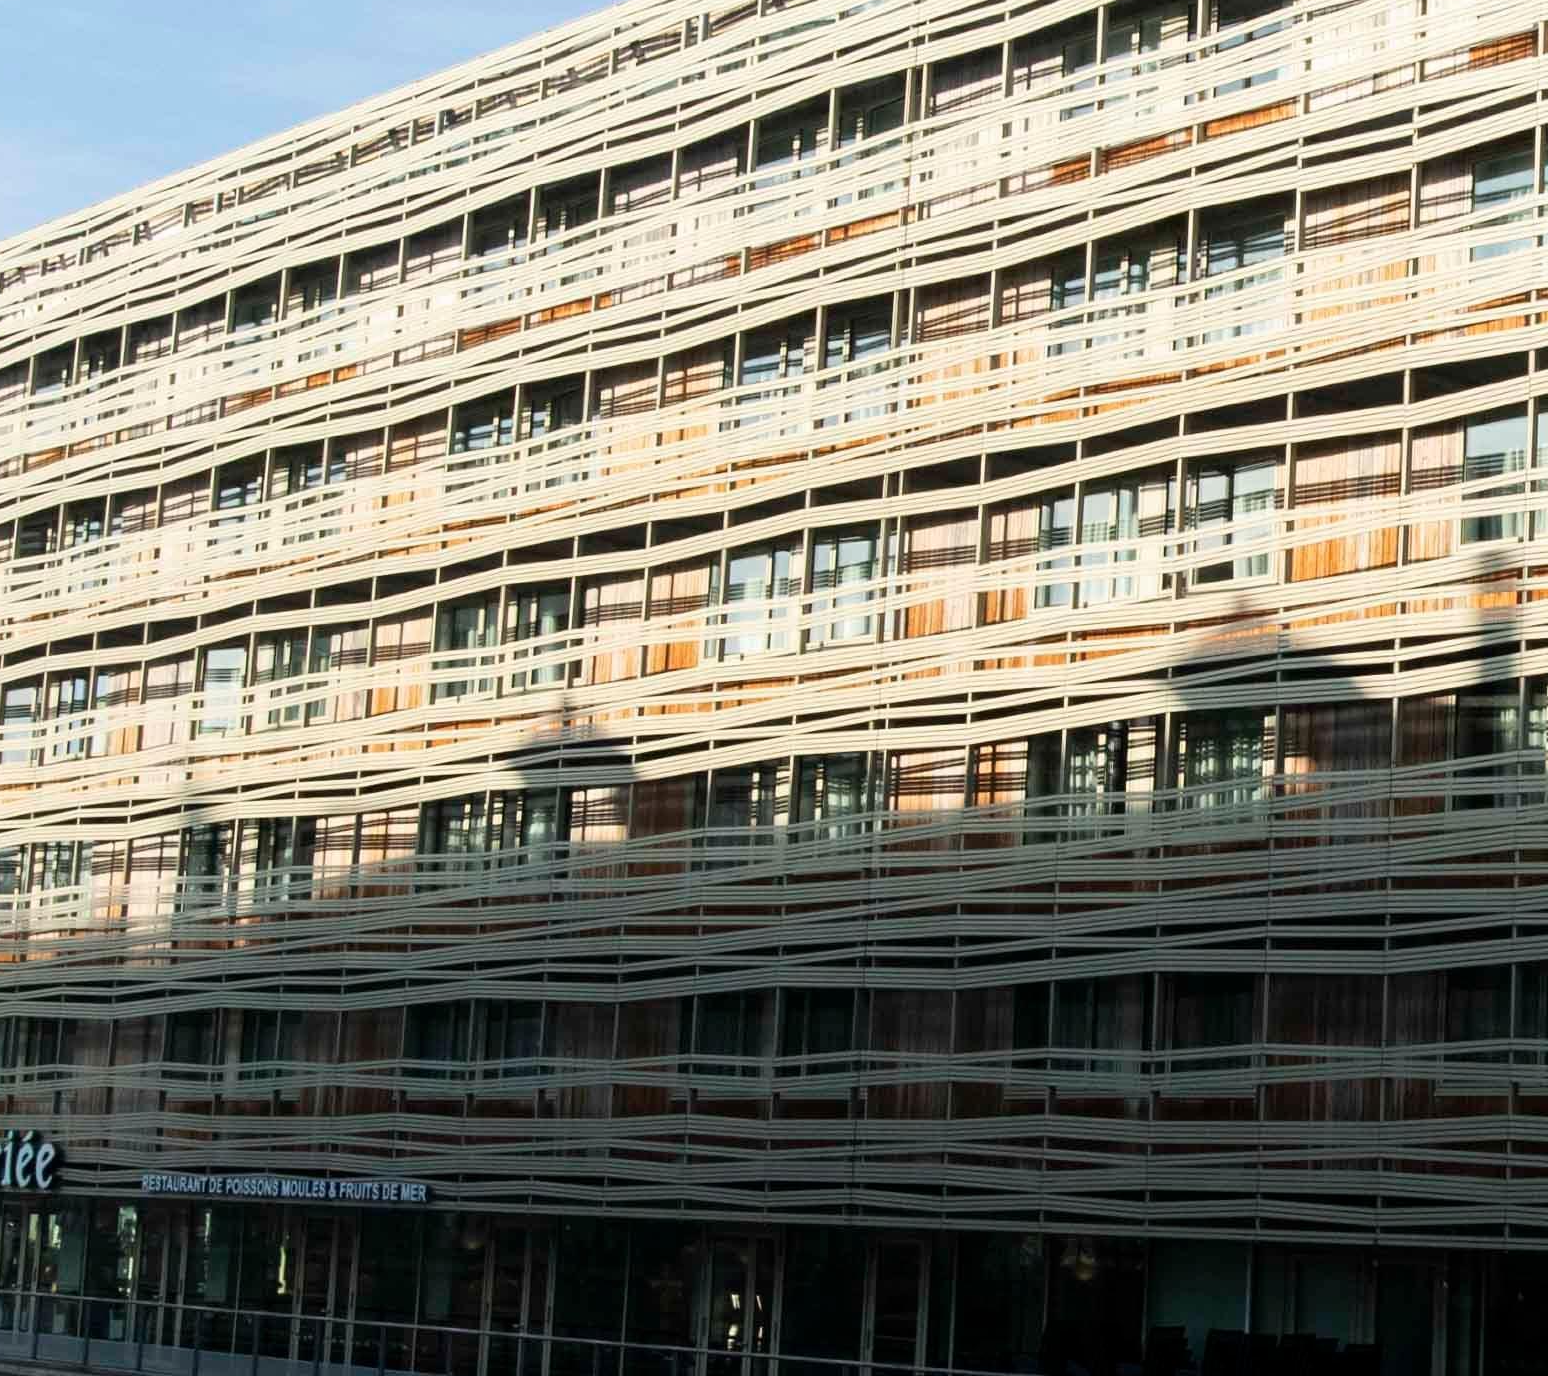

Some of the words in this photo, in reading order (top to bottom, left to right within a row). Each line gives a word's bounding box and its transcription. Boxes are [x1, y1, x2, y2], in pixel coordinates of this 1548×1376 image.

[140, 1174, 208, 1194] RESTAURANT
[209, 1175, 223, 1194] DE
[225, 1177, 279, 1197] POISSONS
[280, 1179, 327, 1199] MOULES
[328, 1181, 338, 1199] &
[339, 1182, 380, 1200] FRUITS
[382, 1184, 399, 1201] DE
[400, 1184, 428, 1202] MER
